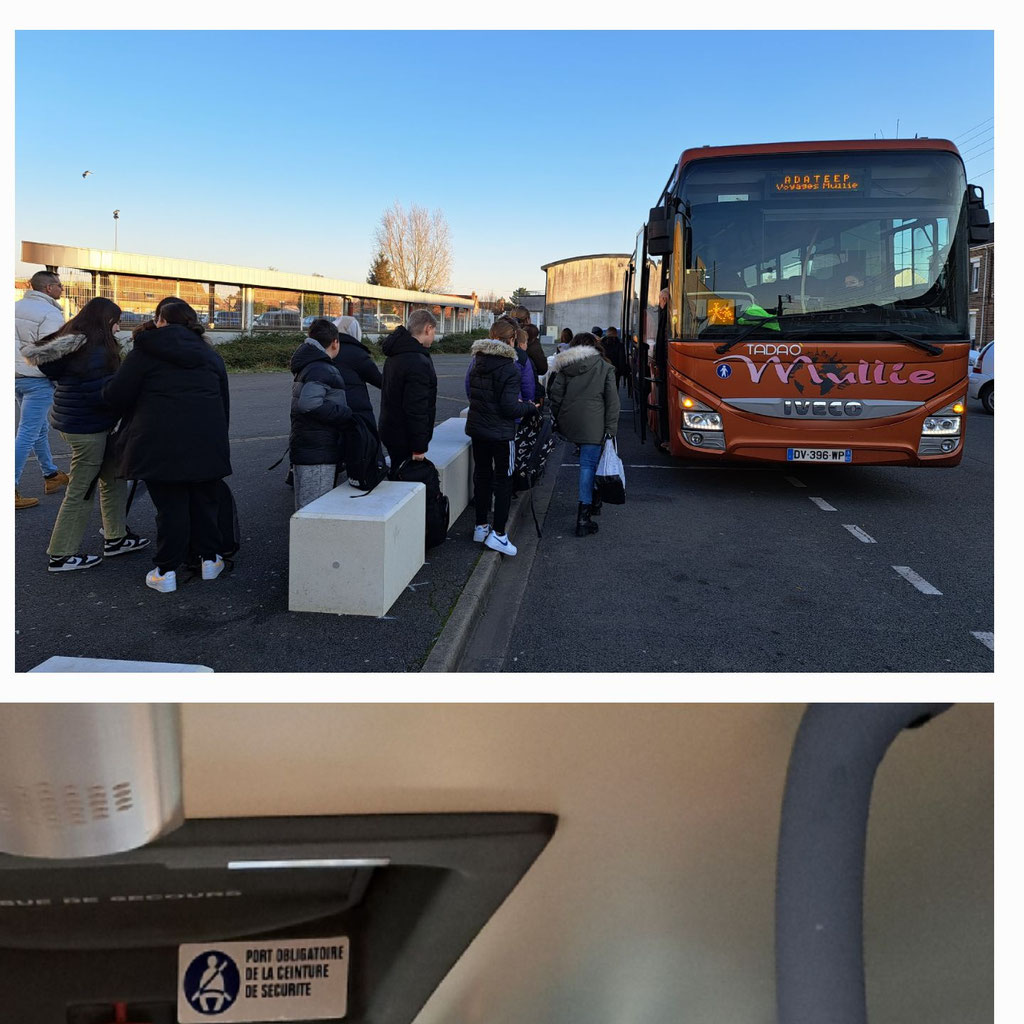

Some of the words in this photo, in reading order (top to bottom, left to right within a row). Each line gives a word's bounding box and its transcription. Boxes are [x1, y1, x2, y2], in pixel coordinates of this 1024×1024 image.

[713, 355, 937, 385] Mullie
[783, 400, 864, 417] IVECO
[793, 449, 845, 461] DV-396-WP
[109, 890, 242, 902] SECOURS
[246, 949, 273, 963] PORT
[277, 945, 344, 962] OBLIGATOIRE
[246, 967, 259, 981] DE
[262, 966, 274, 980] LA
[277, 964, 330, 980] CEINTURE
[245, 985, 258, 998] DE
[261, 982, 312, 998] SECURITE
